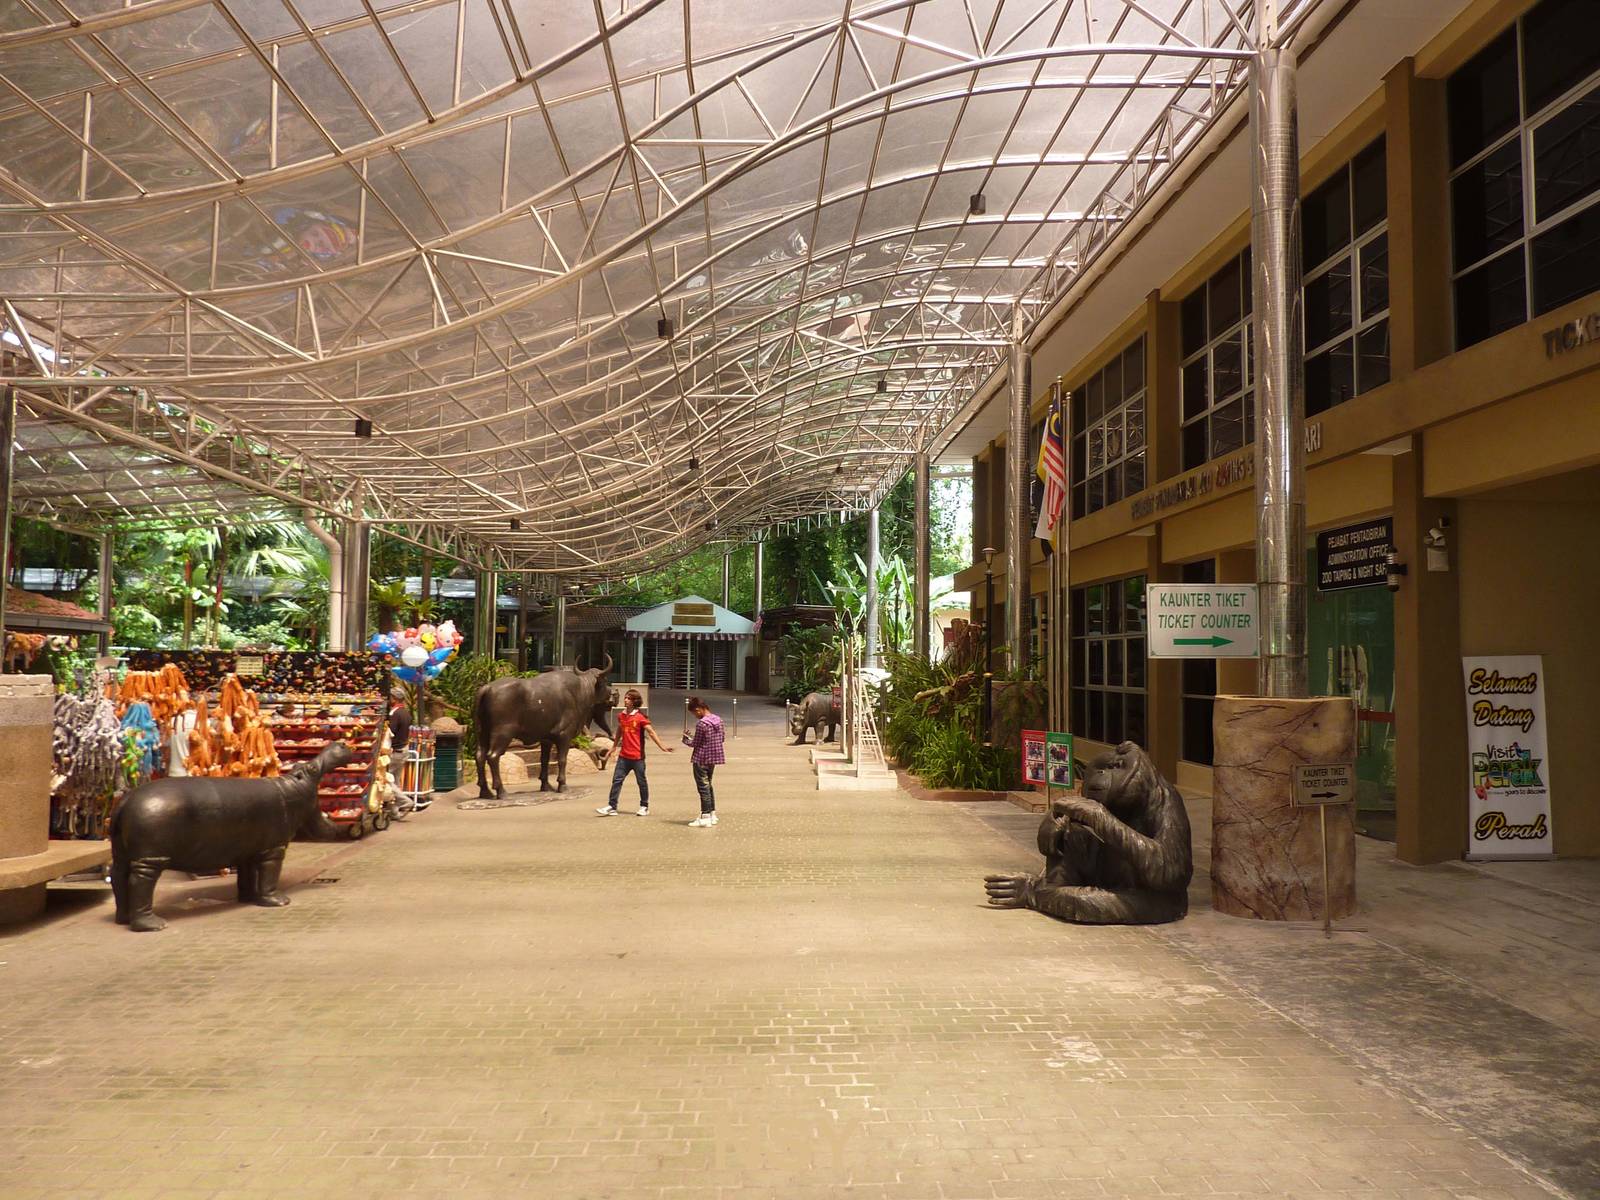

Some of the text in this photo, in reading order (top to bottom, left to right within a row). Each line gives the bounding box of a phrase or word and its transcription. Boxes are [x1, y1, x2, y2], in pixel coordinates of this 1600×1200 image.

[1542, 313, 1600, 360] TICKE
[1328, 526, 1387, 548] PEJABAT PENTADBIRAN
[1328, 544, 1388, 566] ADMINISTRATION OFFICE
[1322, 571, 1332, 584] ZOO
[1333, 568, 1352, 582] TAIPING
[1358, 564, 1374, 579] NIGHT
[1375, 563, 1388, 577] SAF
[1160, 593, 1247, 607] KAUNTER TIKET
[1158, 614, 1251, 629] TICKET COUNTER
[1468, 668, 1537, 695] Selamat
[1473, 699, 1535, 733] Datang
[1486, 743, 1517, 760] Visit
[1300, 778, 1347, 788] TICKET COUNTER
[1303, 768, 1328, 777] KAUNTER
[1474, 811, 1548, 841] Perak
